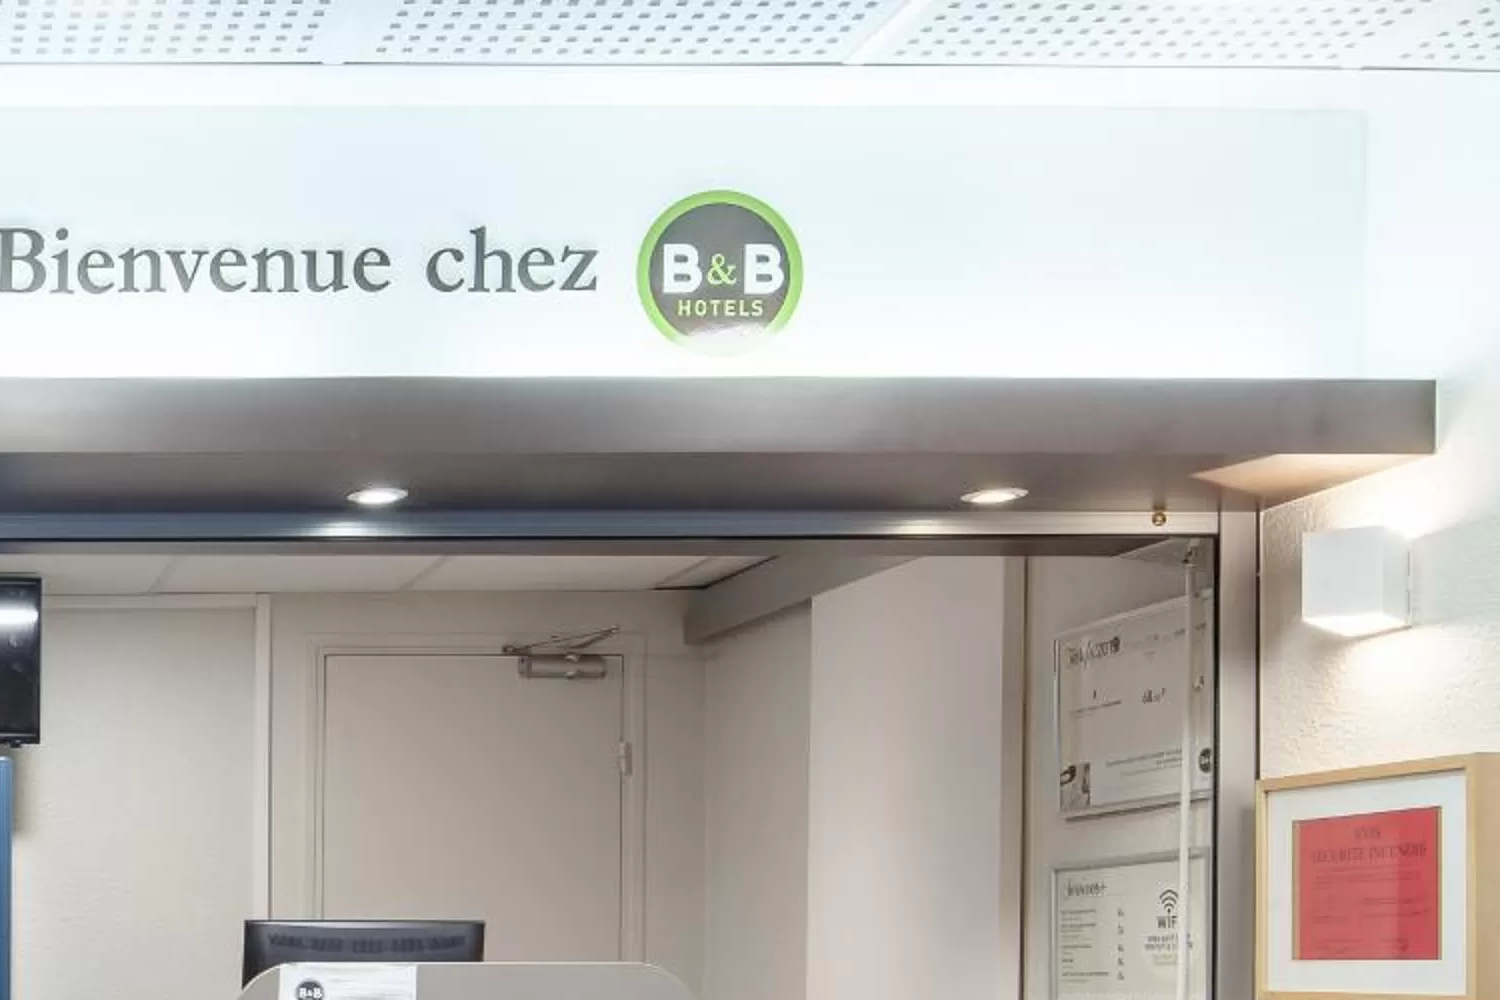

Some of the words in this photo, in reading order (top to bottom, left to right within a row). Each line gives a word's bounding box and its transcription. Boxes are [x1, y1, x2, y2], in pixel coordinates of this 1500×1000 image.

[426, 225, 599, 293] chez
[663, 243, 785, 295] B&B
[677, 299, 764, 318] HOTELS
